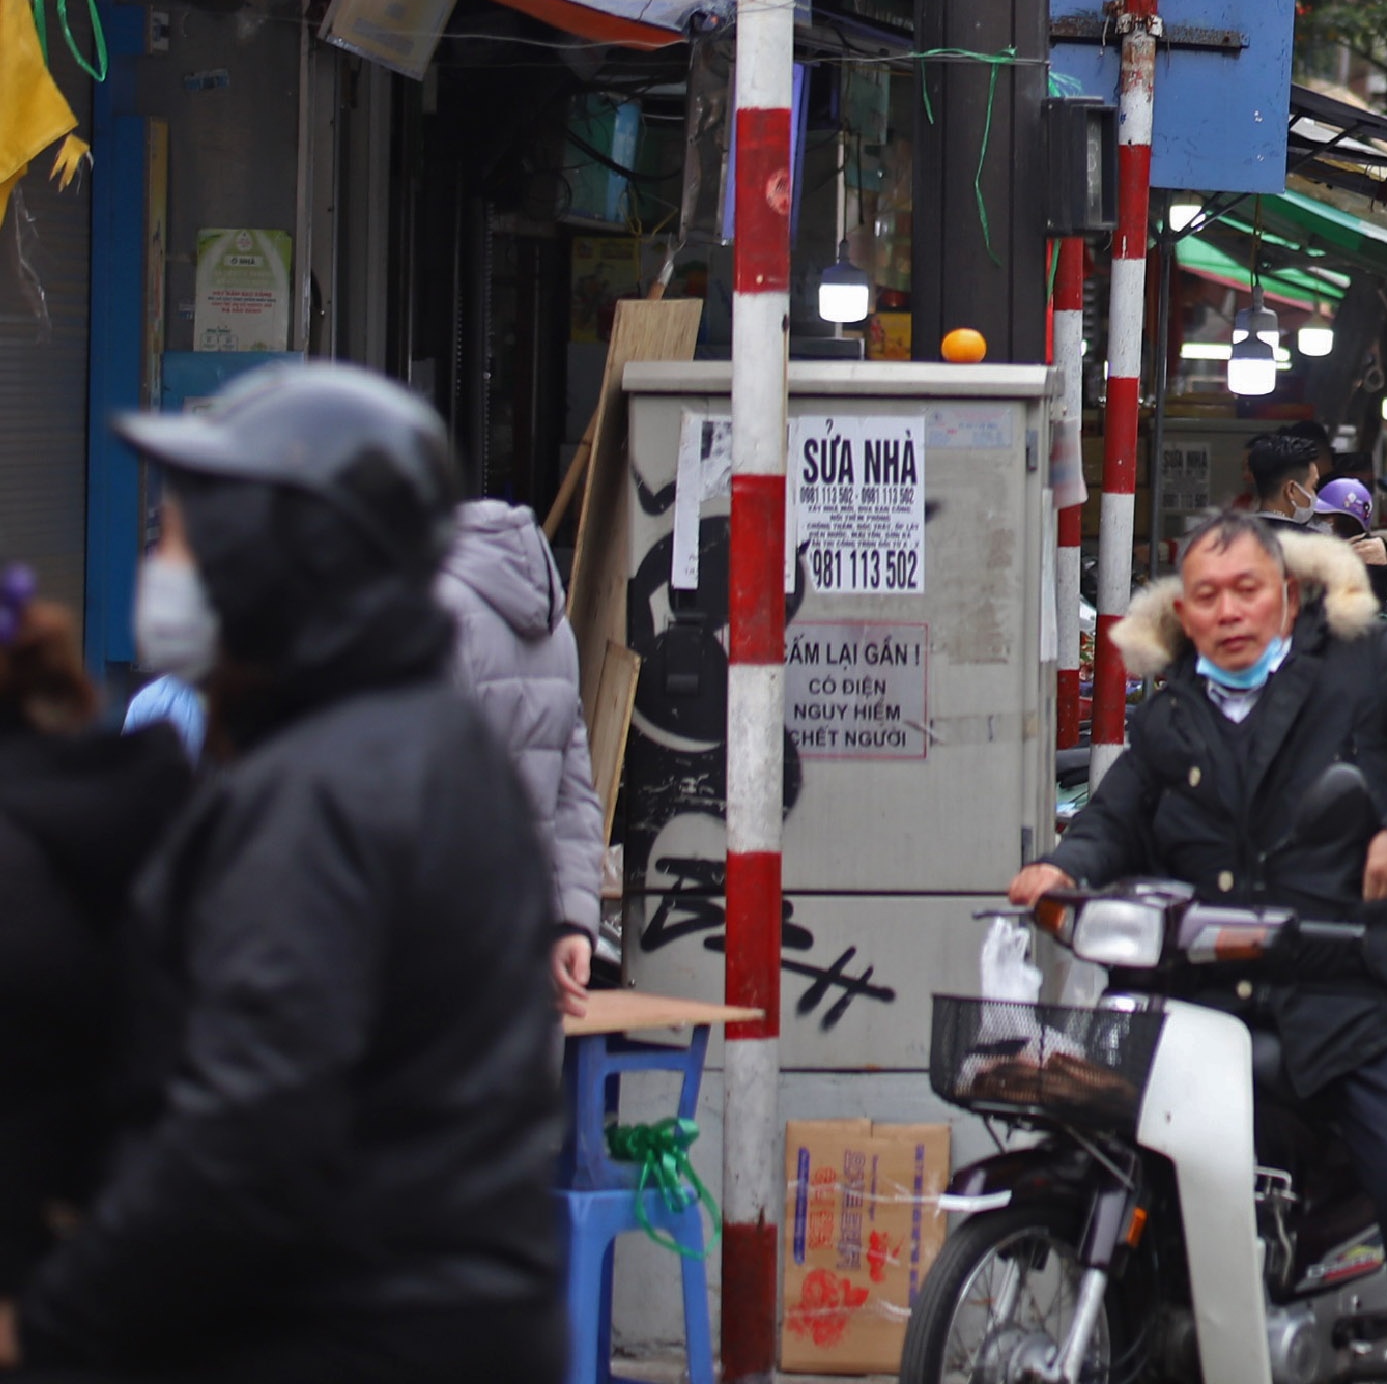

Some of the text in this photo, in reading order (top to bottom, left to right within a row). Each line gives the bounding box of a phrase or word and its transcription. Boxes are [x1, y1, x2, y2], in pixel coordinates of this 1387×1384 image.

[803, 418, 854, 483] SỬA
[864, 429, 917, 484] NHÀ
[811, 549, 917, 590] 981 113 502
[826, 642, 857, 671] LẠI
[809, 674, 886, 699] CÓ ĐIỆN
[794, 703, 848, 721] NGUY
